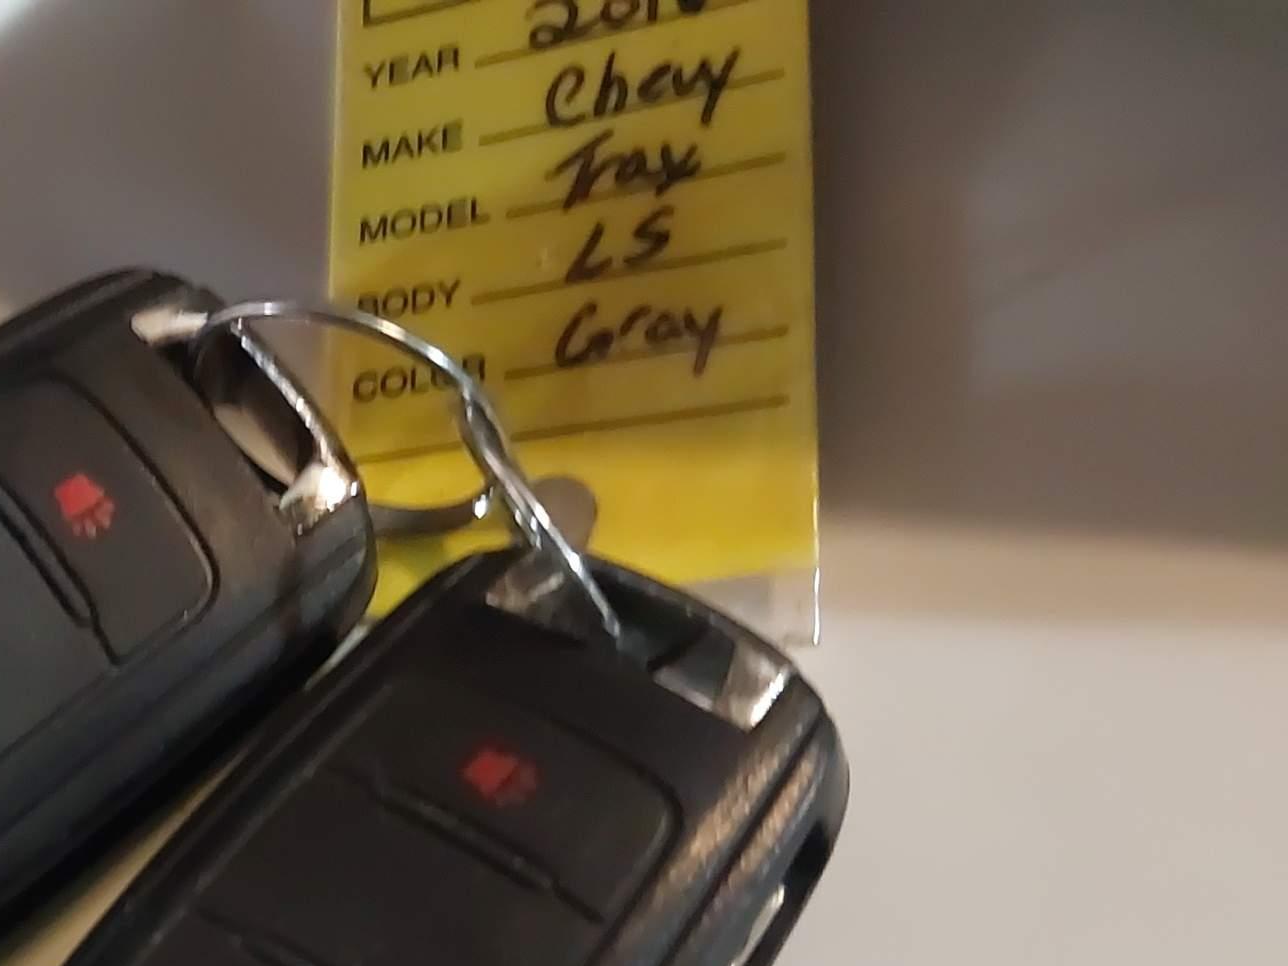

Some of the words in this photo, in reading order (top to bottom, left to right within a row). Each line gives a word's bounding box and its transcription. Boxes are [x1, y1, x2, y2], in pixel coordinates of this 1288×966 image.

[528, 0, 705, 49] 201
[364, 46, 460, 89] YEAR
[362, 119, 462, 168] MAKE
[358, 197, 490, 246] MODEL
[554, 302, 724, 378] Gray
